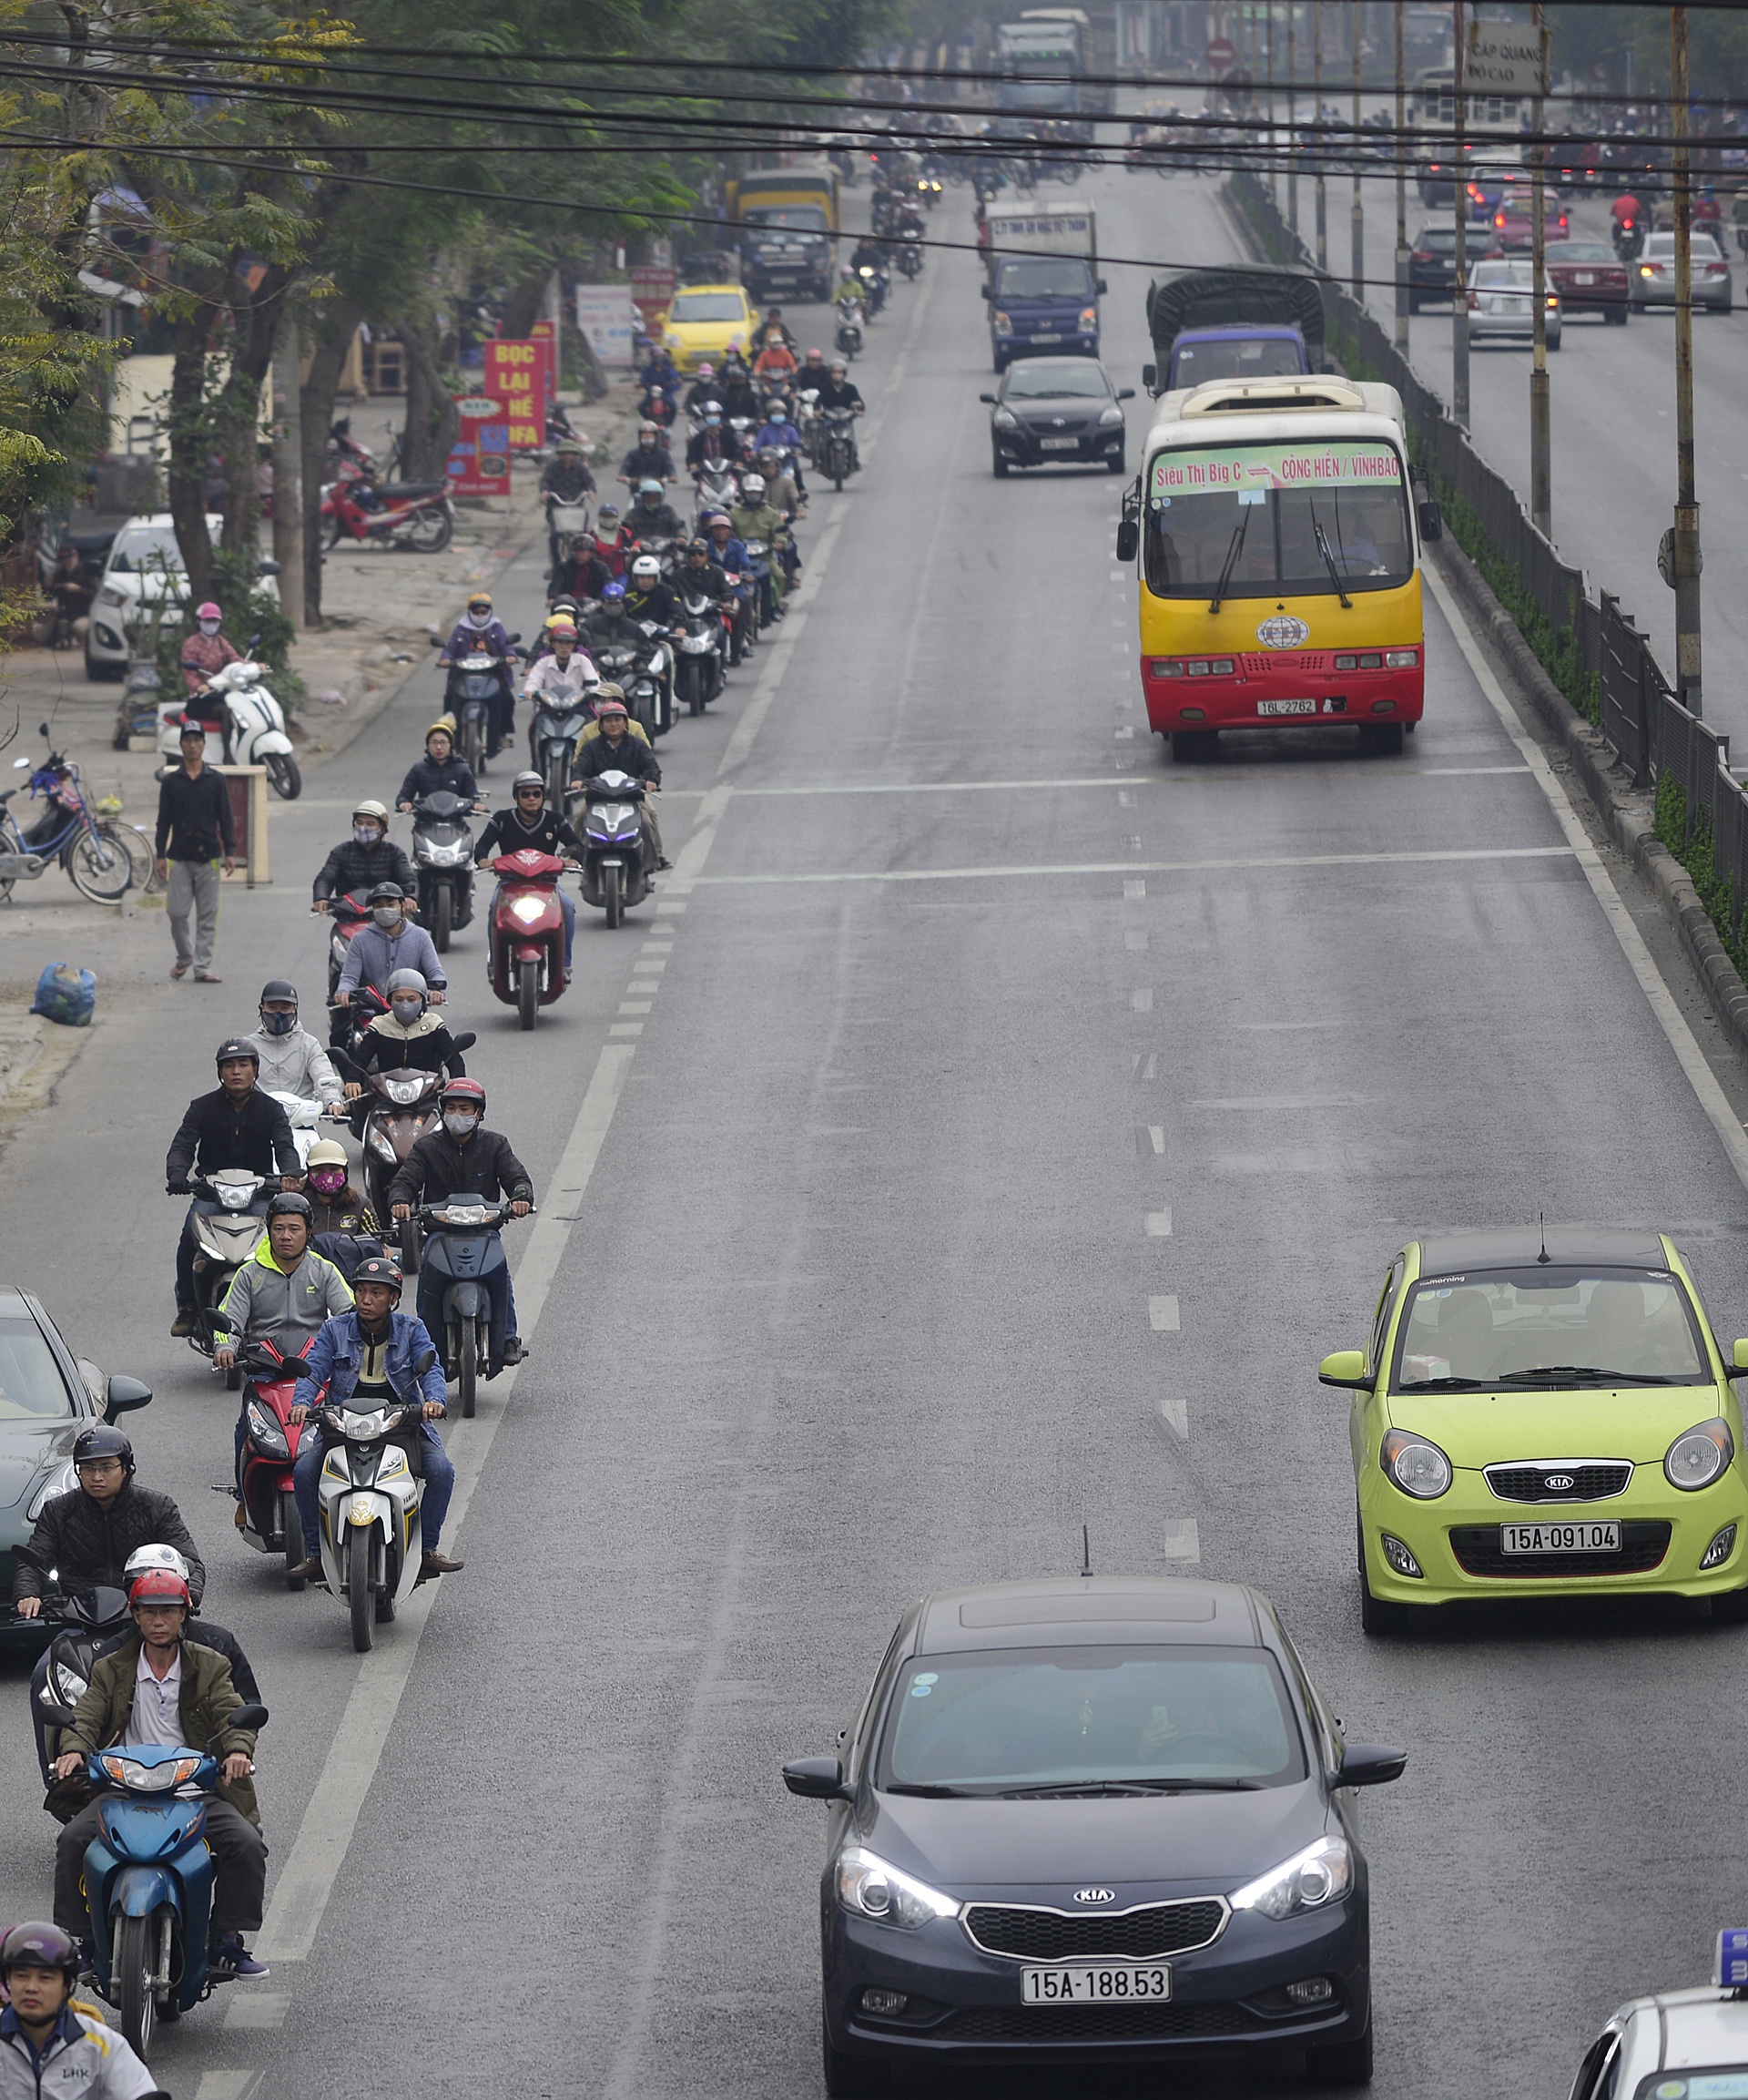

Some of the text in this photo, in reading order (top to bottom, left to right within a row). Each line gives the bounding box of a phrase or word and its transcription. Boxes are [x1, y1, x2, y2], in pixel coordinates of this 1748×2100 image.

[494, 344, 535, 367] BỌC
[499, 372, 531, 393] LẠI
[1156, 465, 1184, 487] Siêu
[1186, 464, 1206, 487] Thị
[1209, 463, 1229, 484] Big
[1233, 462, 1242, 481] C
[1281, 454, 1312, 483] CỘNG
[1314, 448, 1341, 478] HIỀN
[1262, 700, 1313, 714] 16L-2762
[1429, 1276, 1466, 1285] morning
[1550, 1478, 1570, 1487] KIA
[1509, 1525, 1616, 1550] 15A-091.04
[1080, 1890, 1110, 1901] KIA
[1031, 1970, 1164, 1999] 15A-188.53
